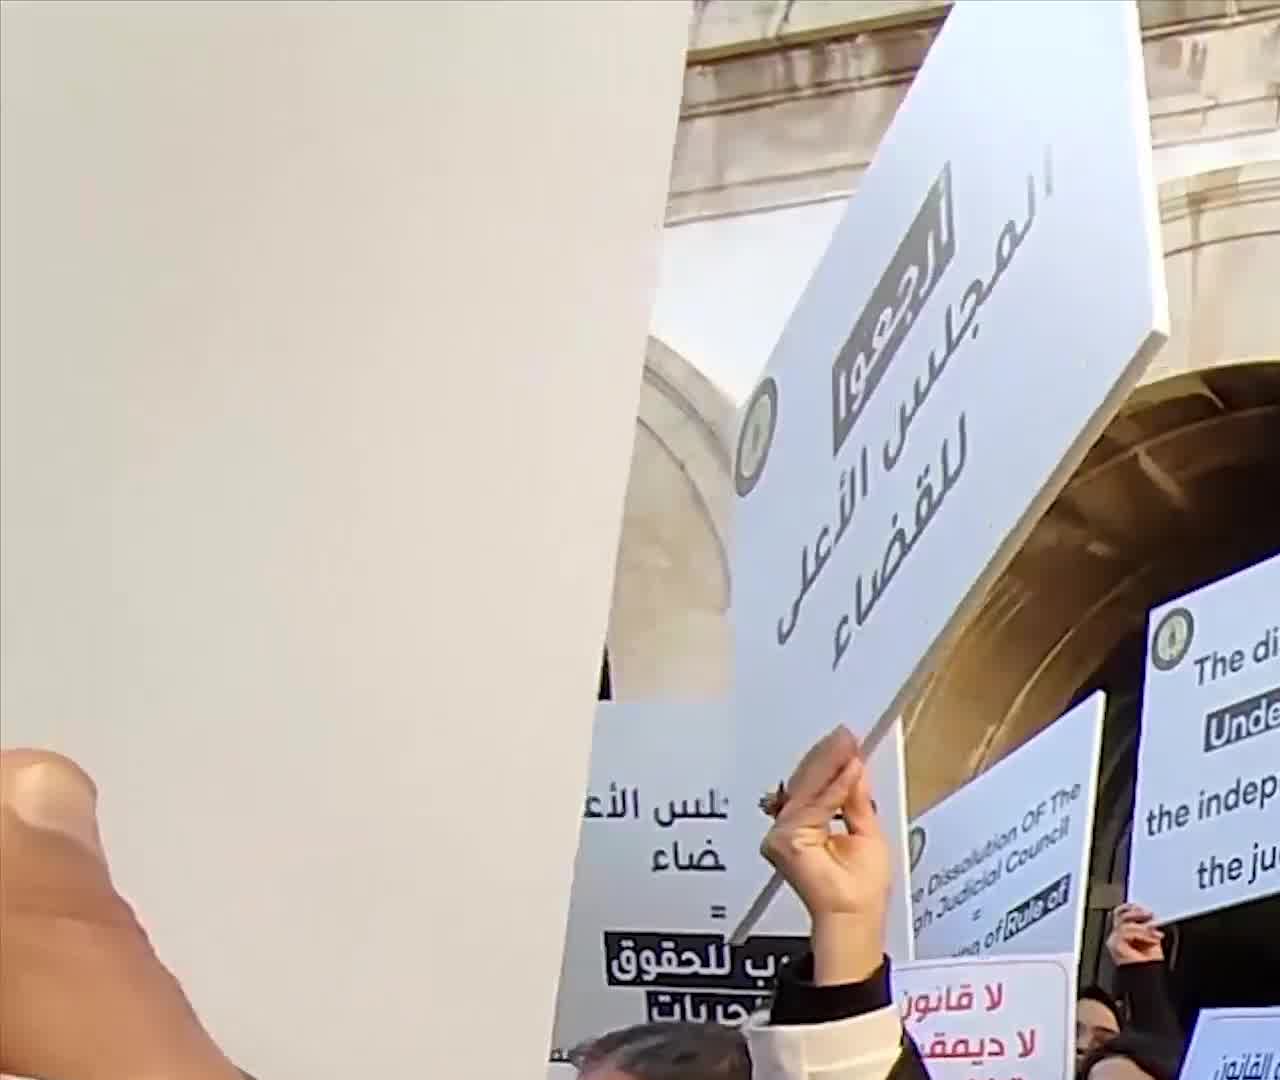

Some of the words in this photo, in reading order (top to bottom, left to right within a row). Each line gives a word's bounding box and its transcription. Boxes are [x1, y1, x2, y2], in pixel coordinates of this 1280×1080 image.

[884, 142, 1053, 472] المجلس
[777, 444, 869, 645] الأعلى
[833, 412, 966, 671] للقضاء
[1194, 646, 1245, 685] The
[584, 782, 639, 819] الأع
[1146, 799, 1190, 836] the
[651, 838, 726, 872] ضاء
[928, 827, 1017, 895] Dissolution
[1022, 801, 1047, 833] OF
[1051, 784, 1081, 814] The
[913, 909, 932, 938] gh
[1006, 815, 1070, 873] Council
[1196, 852, 1244, 889] the
[611, 940, 731, 982] للحقوق
[984, 983, 1003, 1012] لا
[1016, 1029, 1036, 1058] لا
